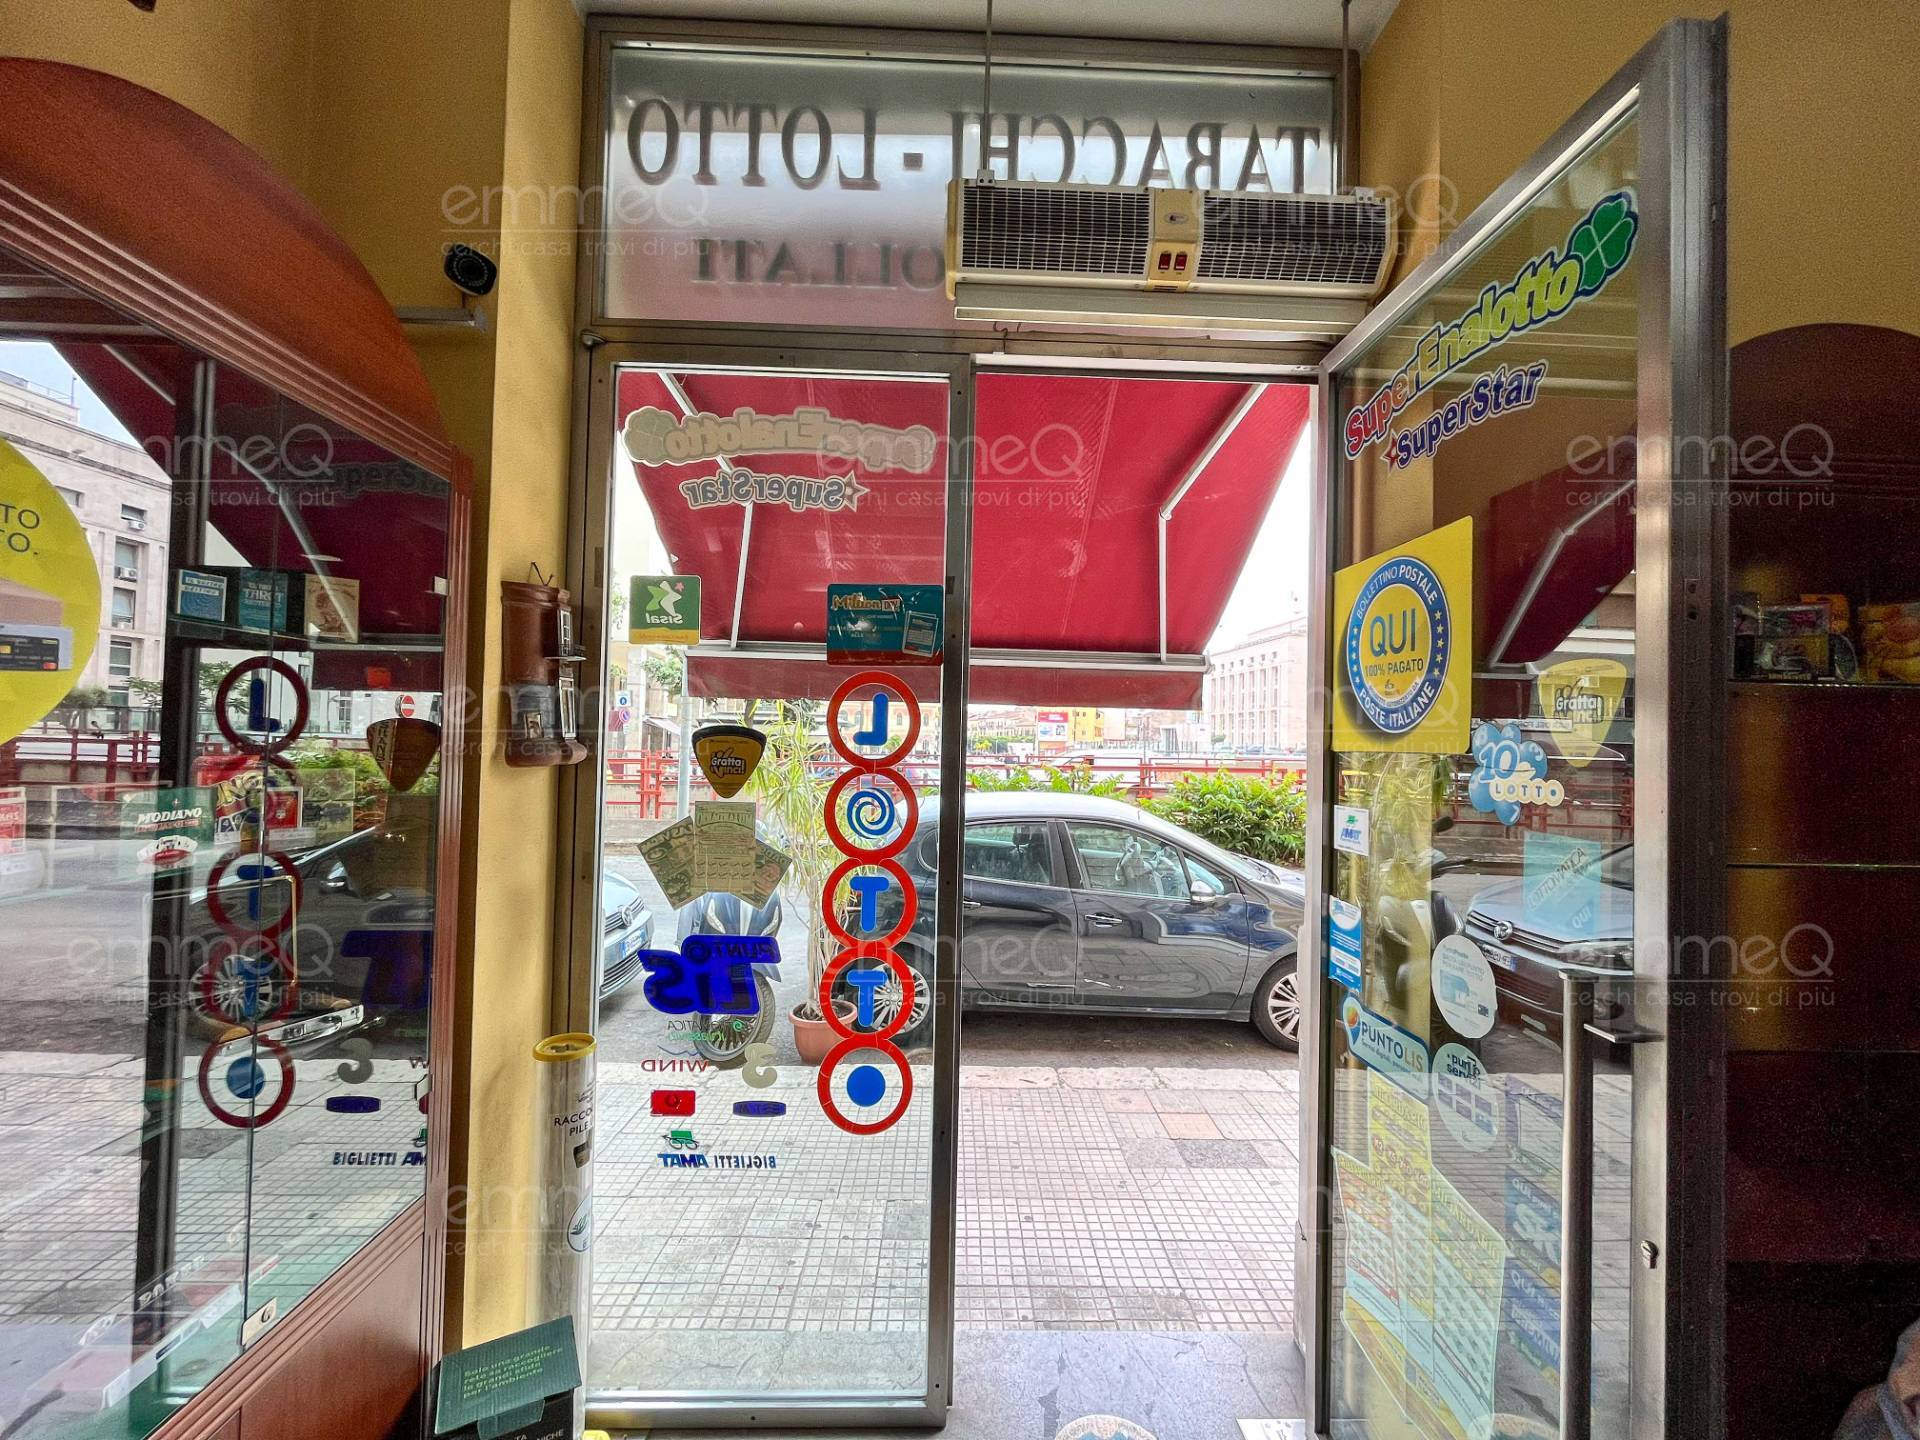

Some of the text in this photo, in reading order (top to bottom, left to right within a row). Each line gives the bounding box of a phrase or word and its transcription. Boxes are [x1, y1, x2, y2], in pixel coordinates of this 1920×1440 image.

[1347, 251, 1583, 457] SuperEnalotto
[1397, 363, 1547, 468] SuperStar
[0, 503, 40, 530] TO
[1356, 564, 1438, 619] BOLLETTINO POSTALE
[1369, 608, 1416, 657] QUI
[1387, 658, 1424, 675] PAGATO
[1358, 689, 1386, 725] POSTE
[1389, 681, 1435, 728] ITALIANE
[1556, 695, 1597, 712] Gratta
[711, 757, 742, 767] Gratta
[1479, 740, 1520, 784] 10
[137, 807, 202, 825] MODIANO
[1571, 906, 1593, 929] QUI
[554, 1107, 592, 1127] RACCO
[333, 1152, 397, 1166] BIGLIETTI
[513, 1345, 550, 1363] grande
